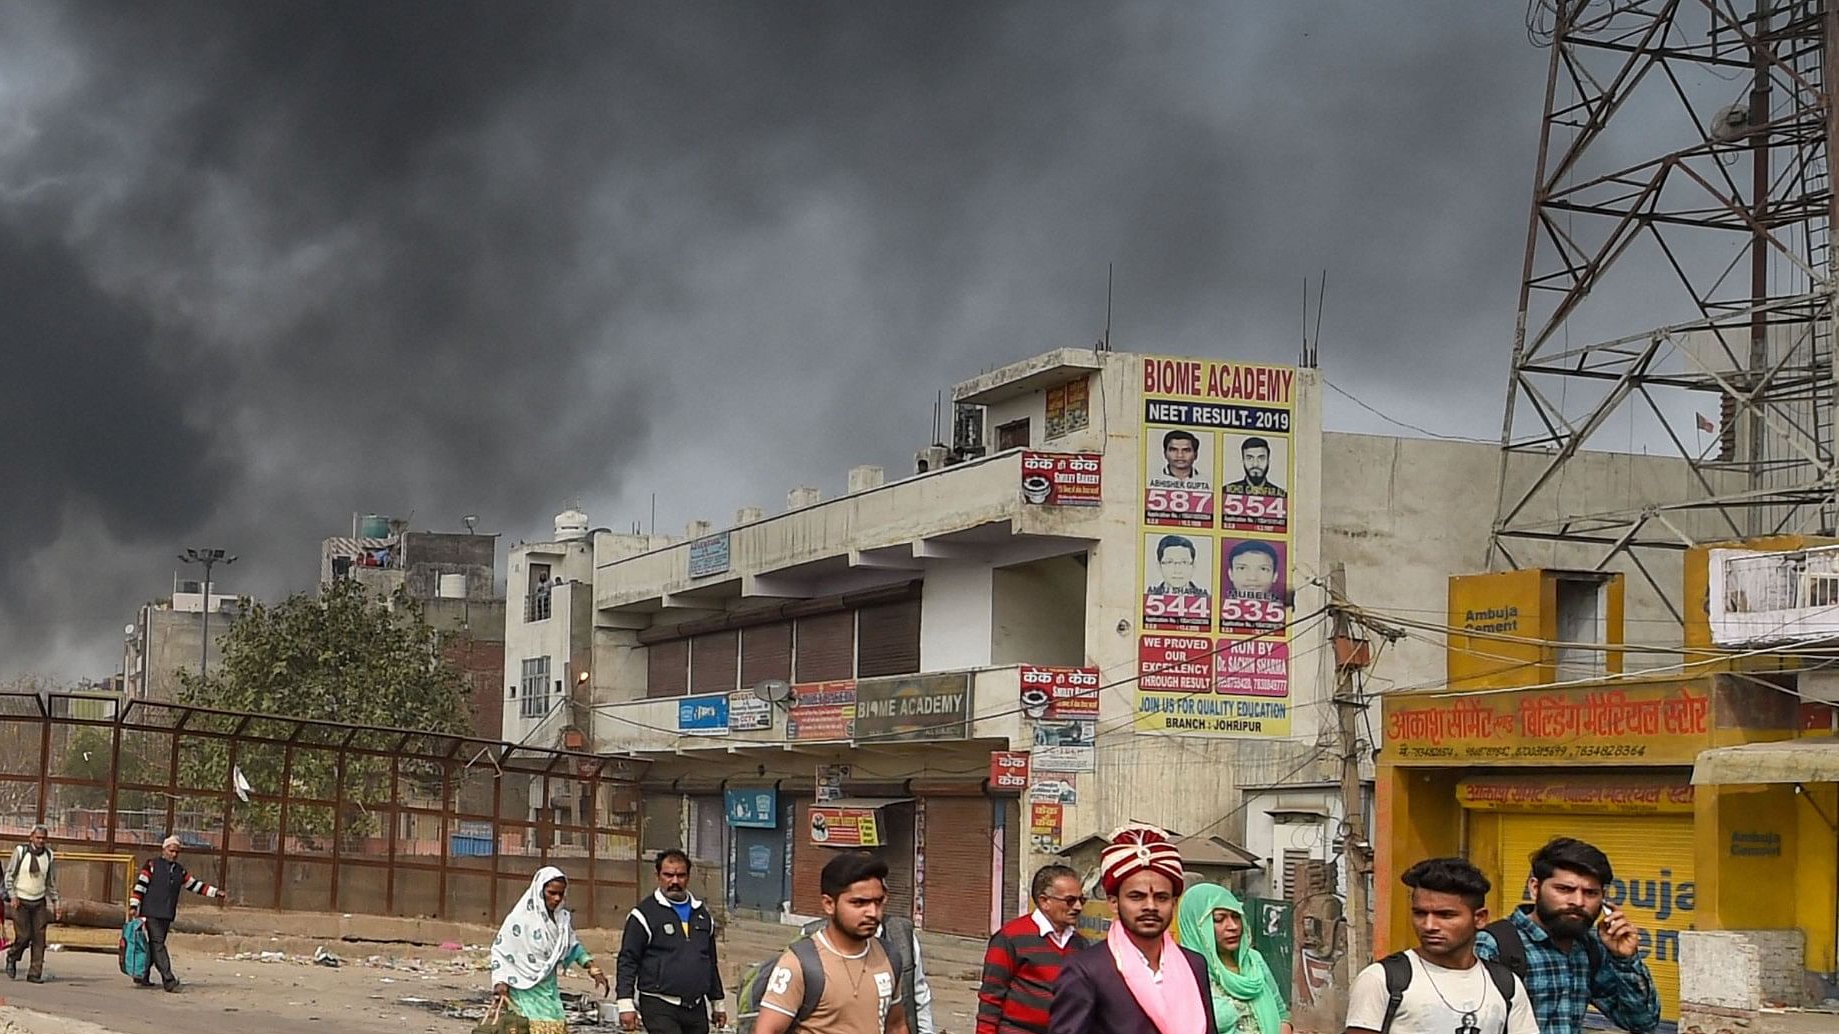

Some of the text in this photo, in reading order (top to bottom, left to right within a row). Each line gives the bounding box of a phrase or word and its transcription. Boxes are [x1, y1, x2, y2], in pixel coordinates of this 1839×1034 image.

[1144, 358, 1293, 403] BIOME ACADEMY
[1149, 403, 1188, 422] NEET
[1256, 411, 1289, 430] 2019
[1023, 454, 1055, 470] केक
[1069, 455, 1099, 472] केक
[1147, 490, 1212, 514] 587
[1224, 494, 1286, 518] 554
[1145, 595, 1210, 618] 544
[1222, 598, 1285, 622] 535
[1465, 605, 1518, 622] Ambuja
[1144, 637, 1208, 649] WE PROVED
[1230, 641, 1274, 655] RUN BY
[1165, 651, 1187, 662] OUR
[1022, 667, 1054, 683] केक
[1068, 669, 1098, 685] केक
[1142, 662, 1209, 675] EXCELLENCY
[1256, 658, 1287, 676] SHARMA
[1140, 675, 1211, 689] THROUGH RESULT
[899, 694, 963, 715] ACADEMY
[1138, 697, 1286, 719] JOIN US FOR QUALITY EDUCATION
[1386, 708, 1443, 745] आकाश
[1662, 686, 1709, 735] स्टोर
[1165, 717, 1206, 730] BRANCH
[1214, 719, 1262, 733] JOHRIPUR
[998, 754, 1027, 767] केक
[997, 772, 1026, 785] केक
